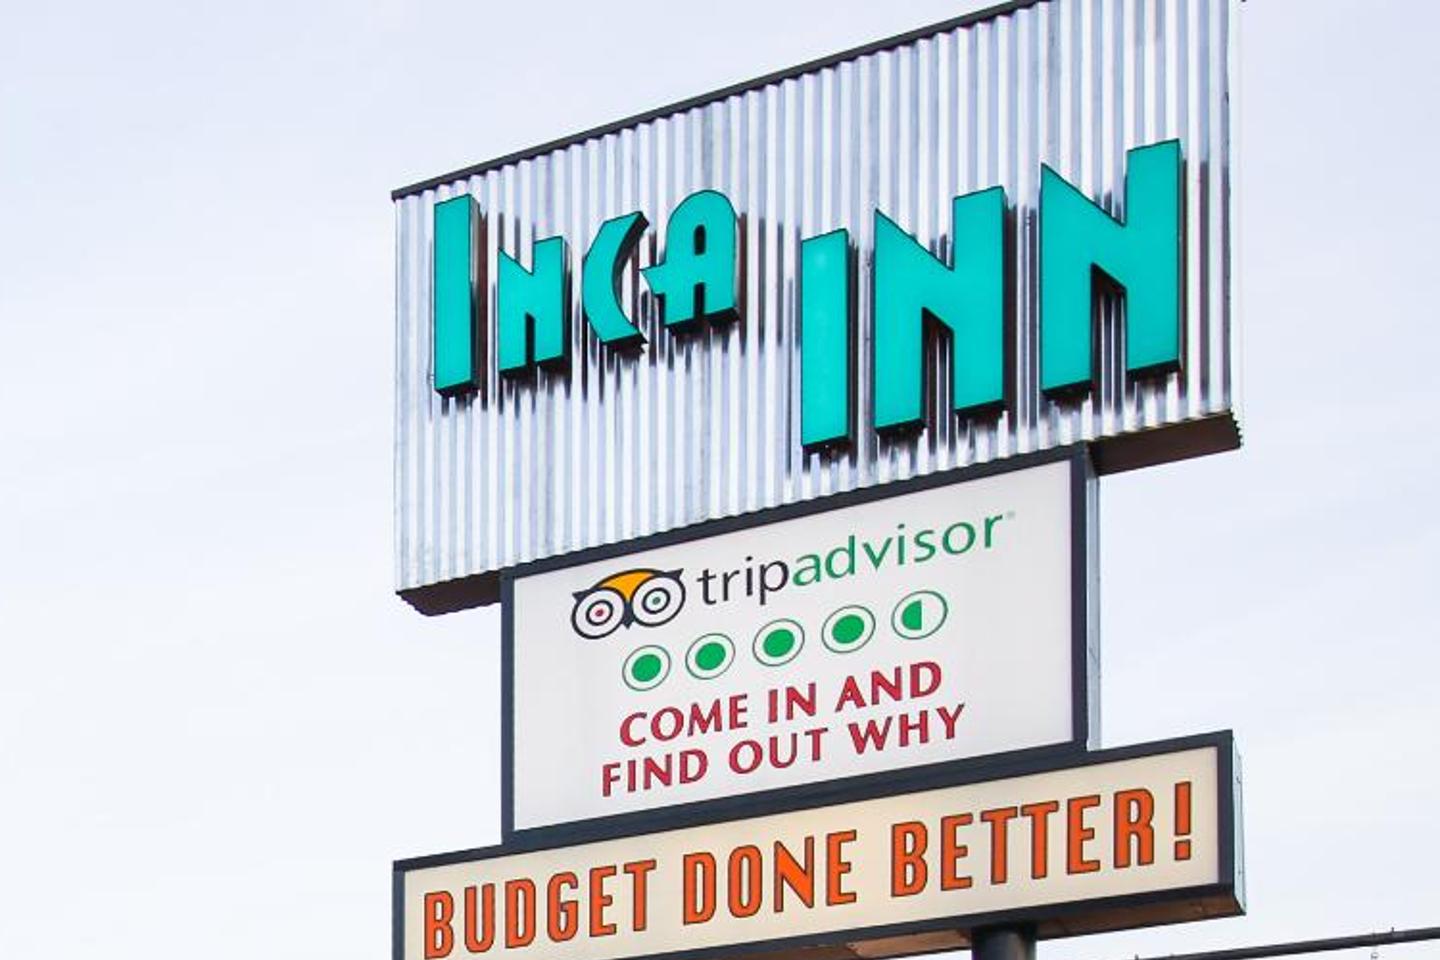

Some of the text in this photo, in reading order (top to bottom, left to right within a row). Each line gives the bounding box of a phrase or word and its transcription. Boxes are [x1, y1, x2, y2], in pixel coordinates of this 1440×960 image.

[434, 138, 1182, 452] INCA INN
[697, 511, 1005, 606] tripadvisor
[602, 703, 966, 798] FIND OUT WHY
[620, 661, 943, 748] COME IN AND
[423, 780, 1193, 960] BUDGET DONE BETTER!
